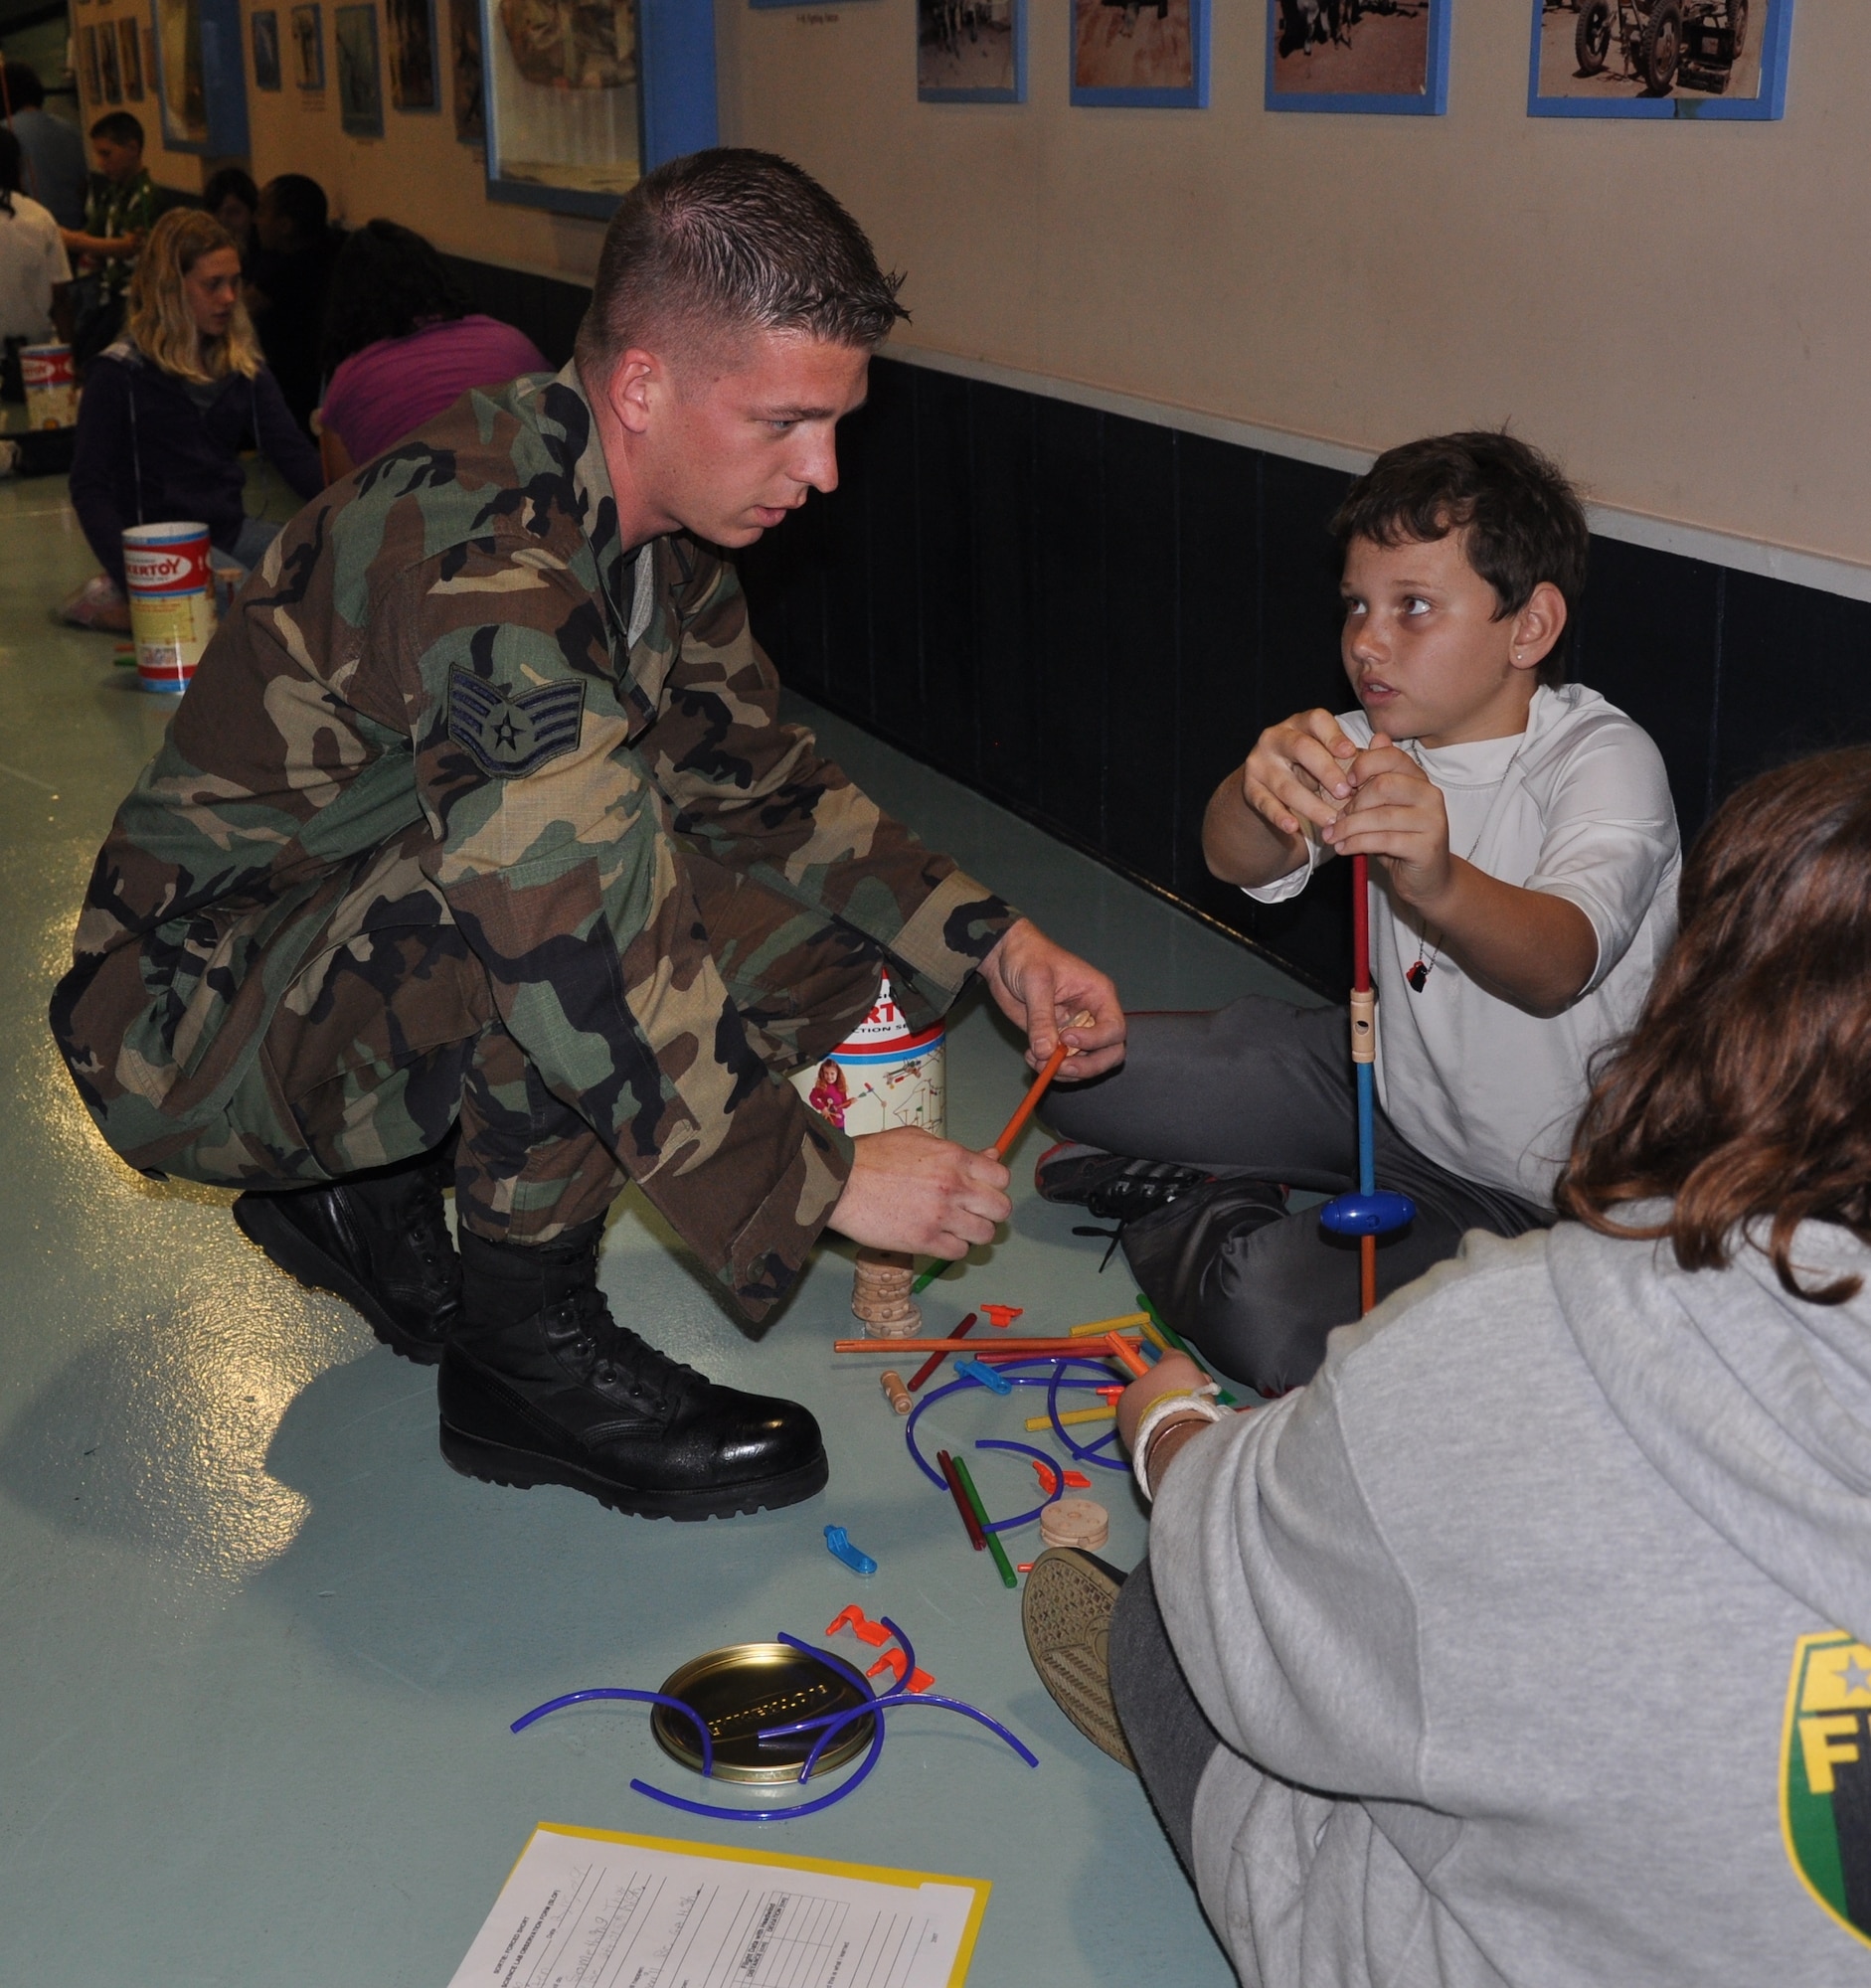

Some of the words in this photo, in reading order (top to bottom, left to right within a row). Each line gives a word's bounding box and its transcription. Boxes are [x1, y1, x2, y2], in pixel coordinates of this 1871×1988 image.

[1797, 1712, 1871, 1794] F
[760, 1903, 776, 1927] Headwind
[766, 1907, 781, 1932] DEVIATION
[493, 1954, 508, 1974] SORTIE:
[505, 1933, 520, 1953] FORCED
[517, 1915, 530, 1933] SHORT
[501, 1965, 517, 1988] SCIENCE
[513, 1954, 524, 1965] LAB
[519, 1920, 543, 1954] OBSERVATION
[539, 1905, 551, 1920] FORM
[548, 1890, 562, 1905] (SLOF)
[546, 1928, 557, 1938] Date
[756, 1928, 765, 1939] with
[749, 1940, 759, 1952] Data
[741, 1953, 753, 1969] Flight
[747, 1953, 763, 1977] DISTANCE
